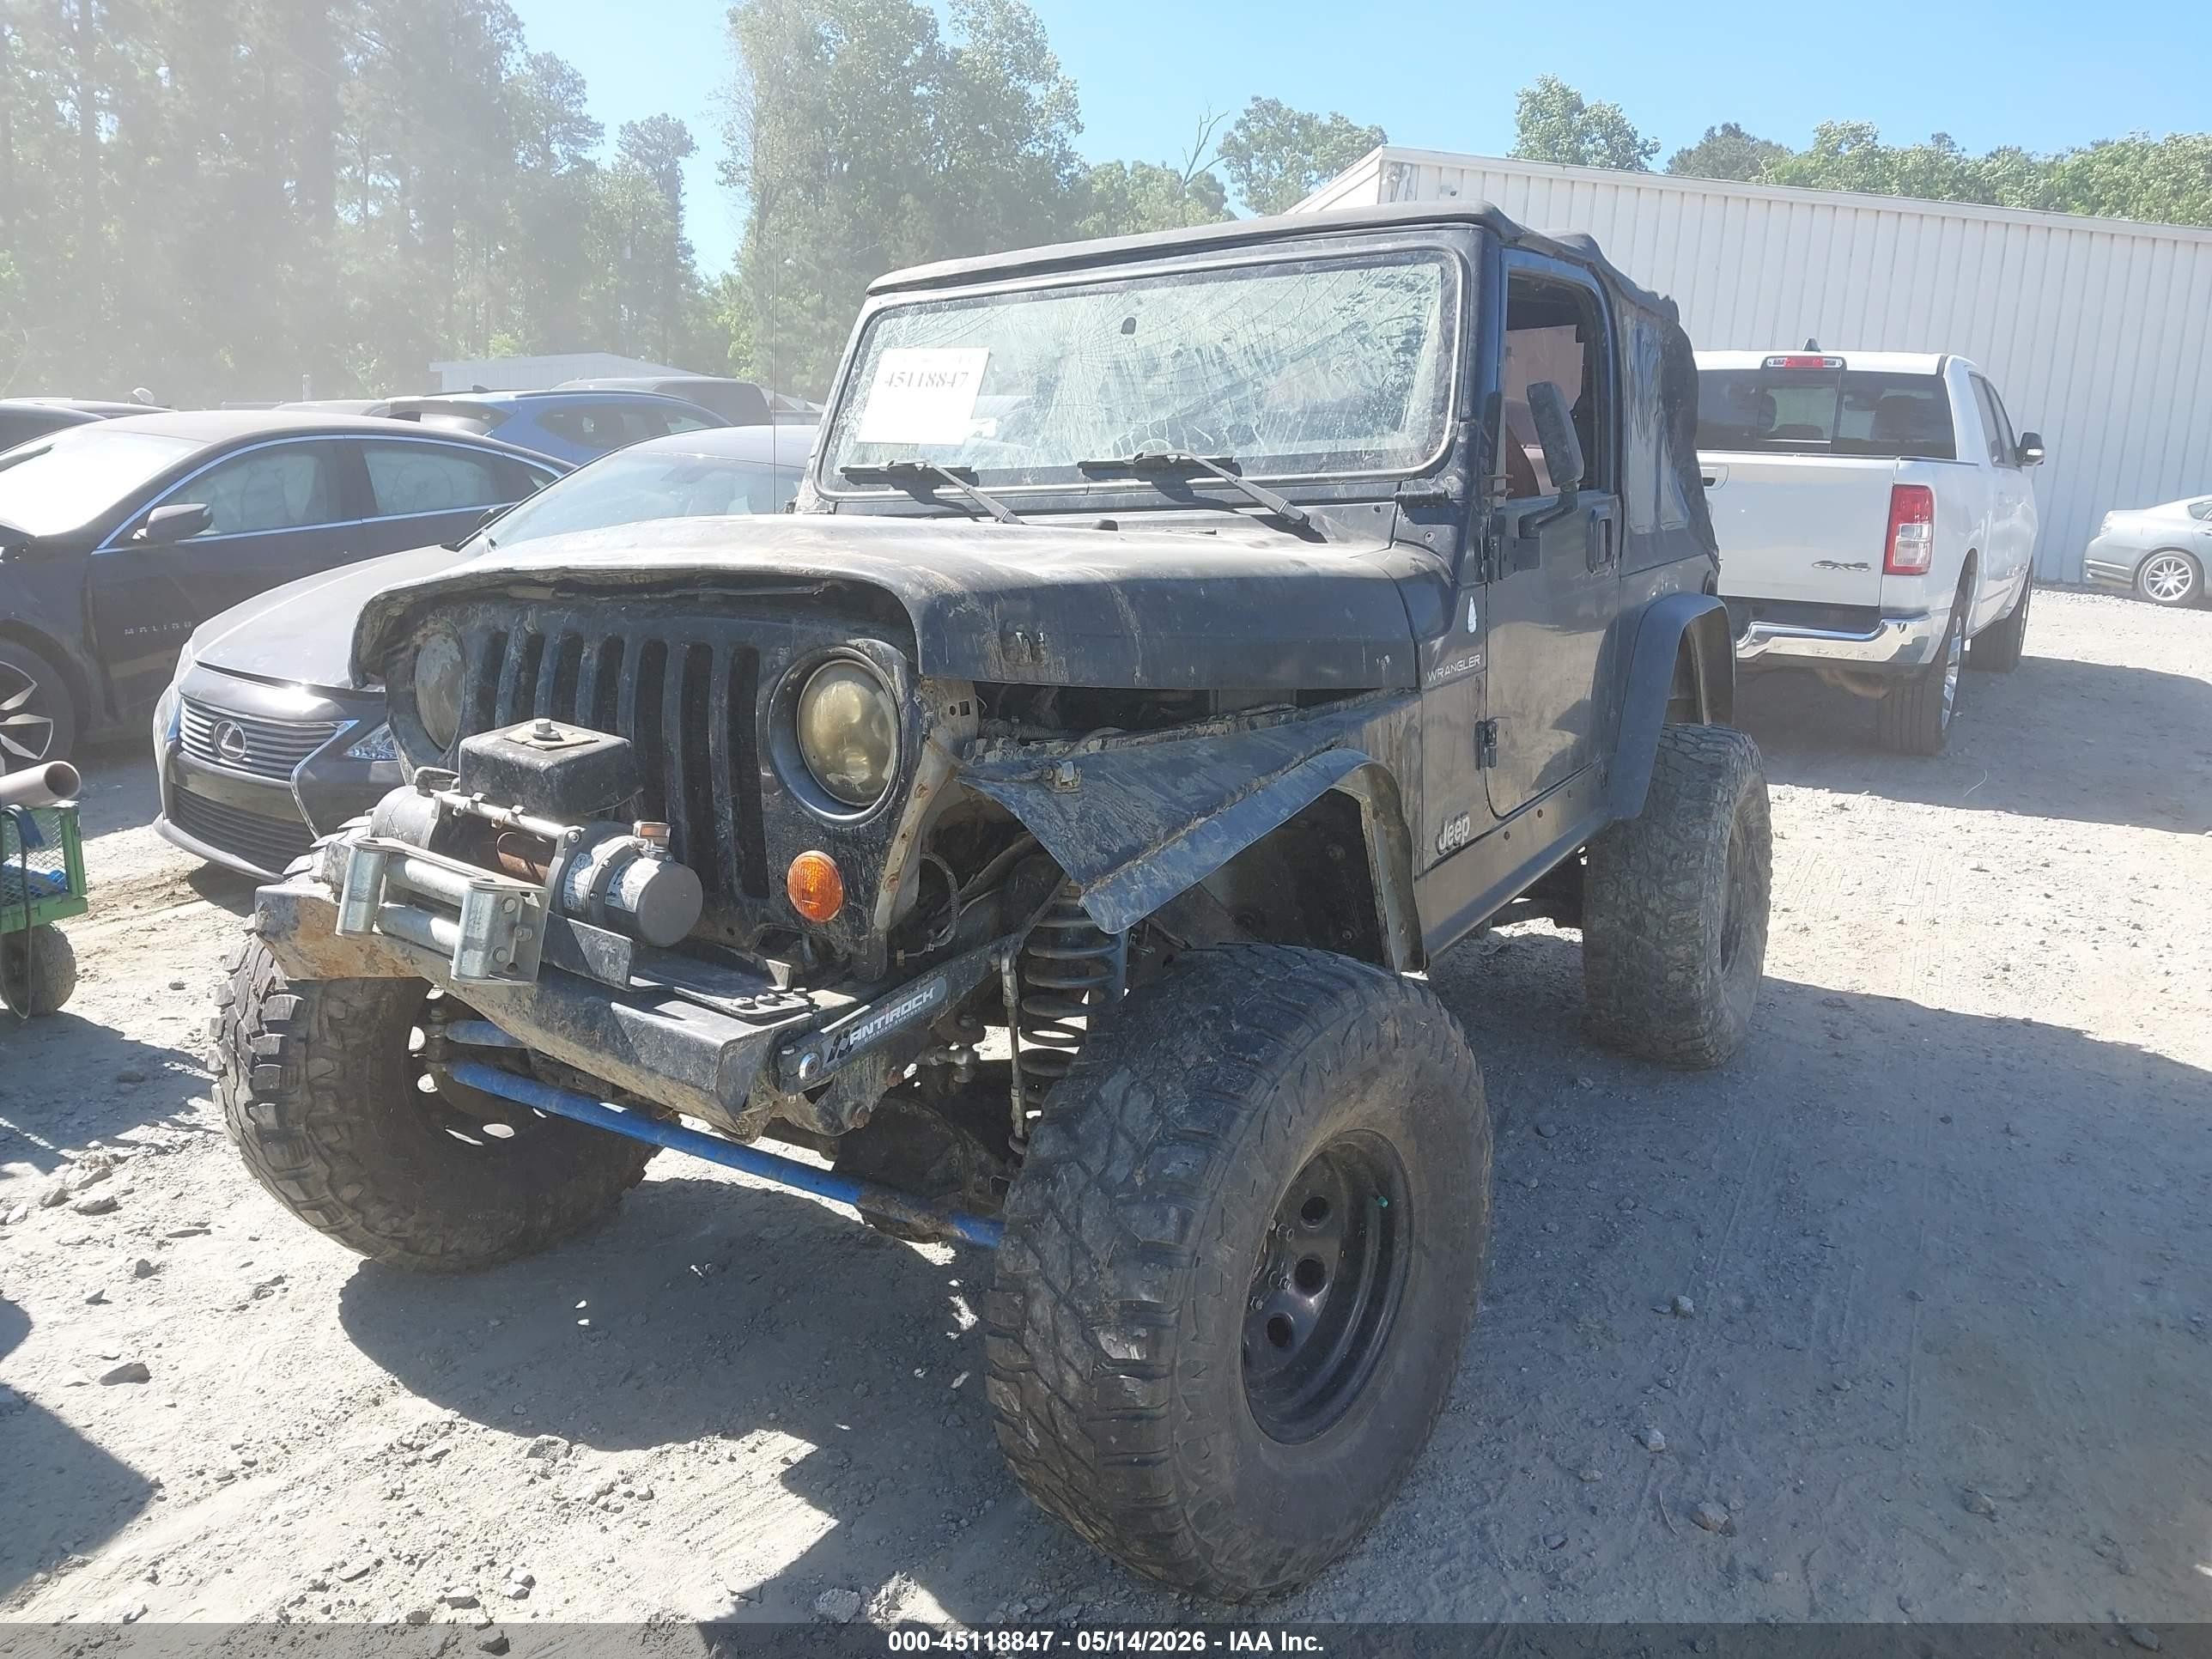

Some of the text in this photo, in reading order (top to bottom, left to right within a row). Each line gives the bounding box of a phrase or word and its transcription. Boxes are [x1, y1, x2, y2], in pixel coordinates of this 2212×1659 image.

[884, 372, 969, 387] 45118847
[1427, 654, 1480, 683] WRANGLER
[1438, 817, 1469, 850] Jeep
[849, 987, 935, 1046] ANTIROCK
